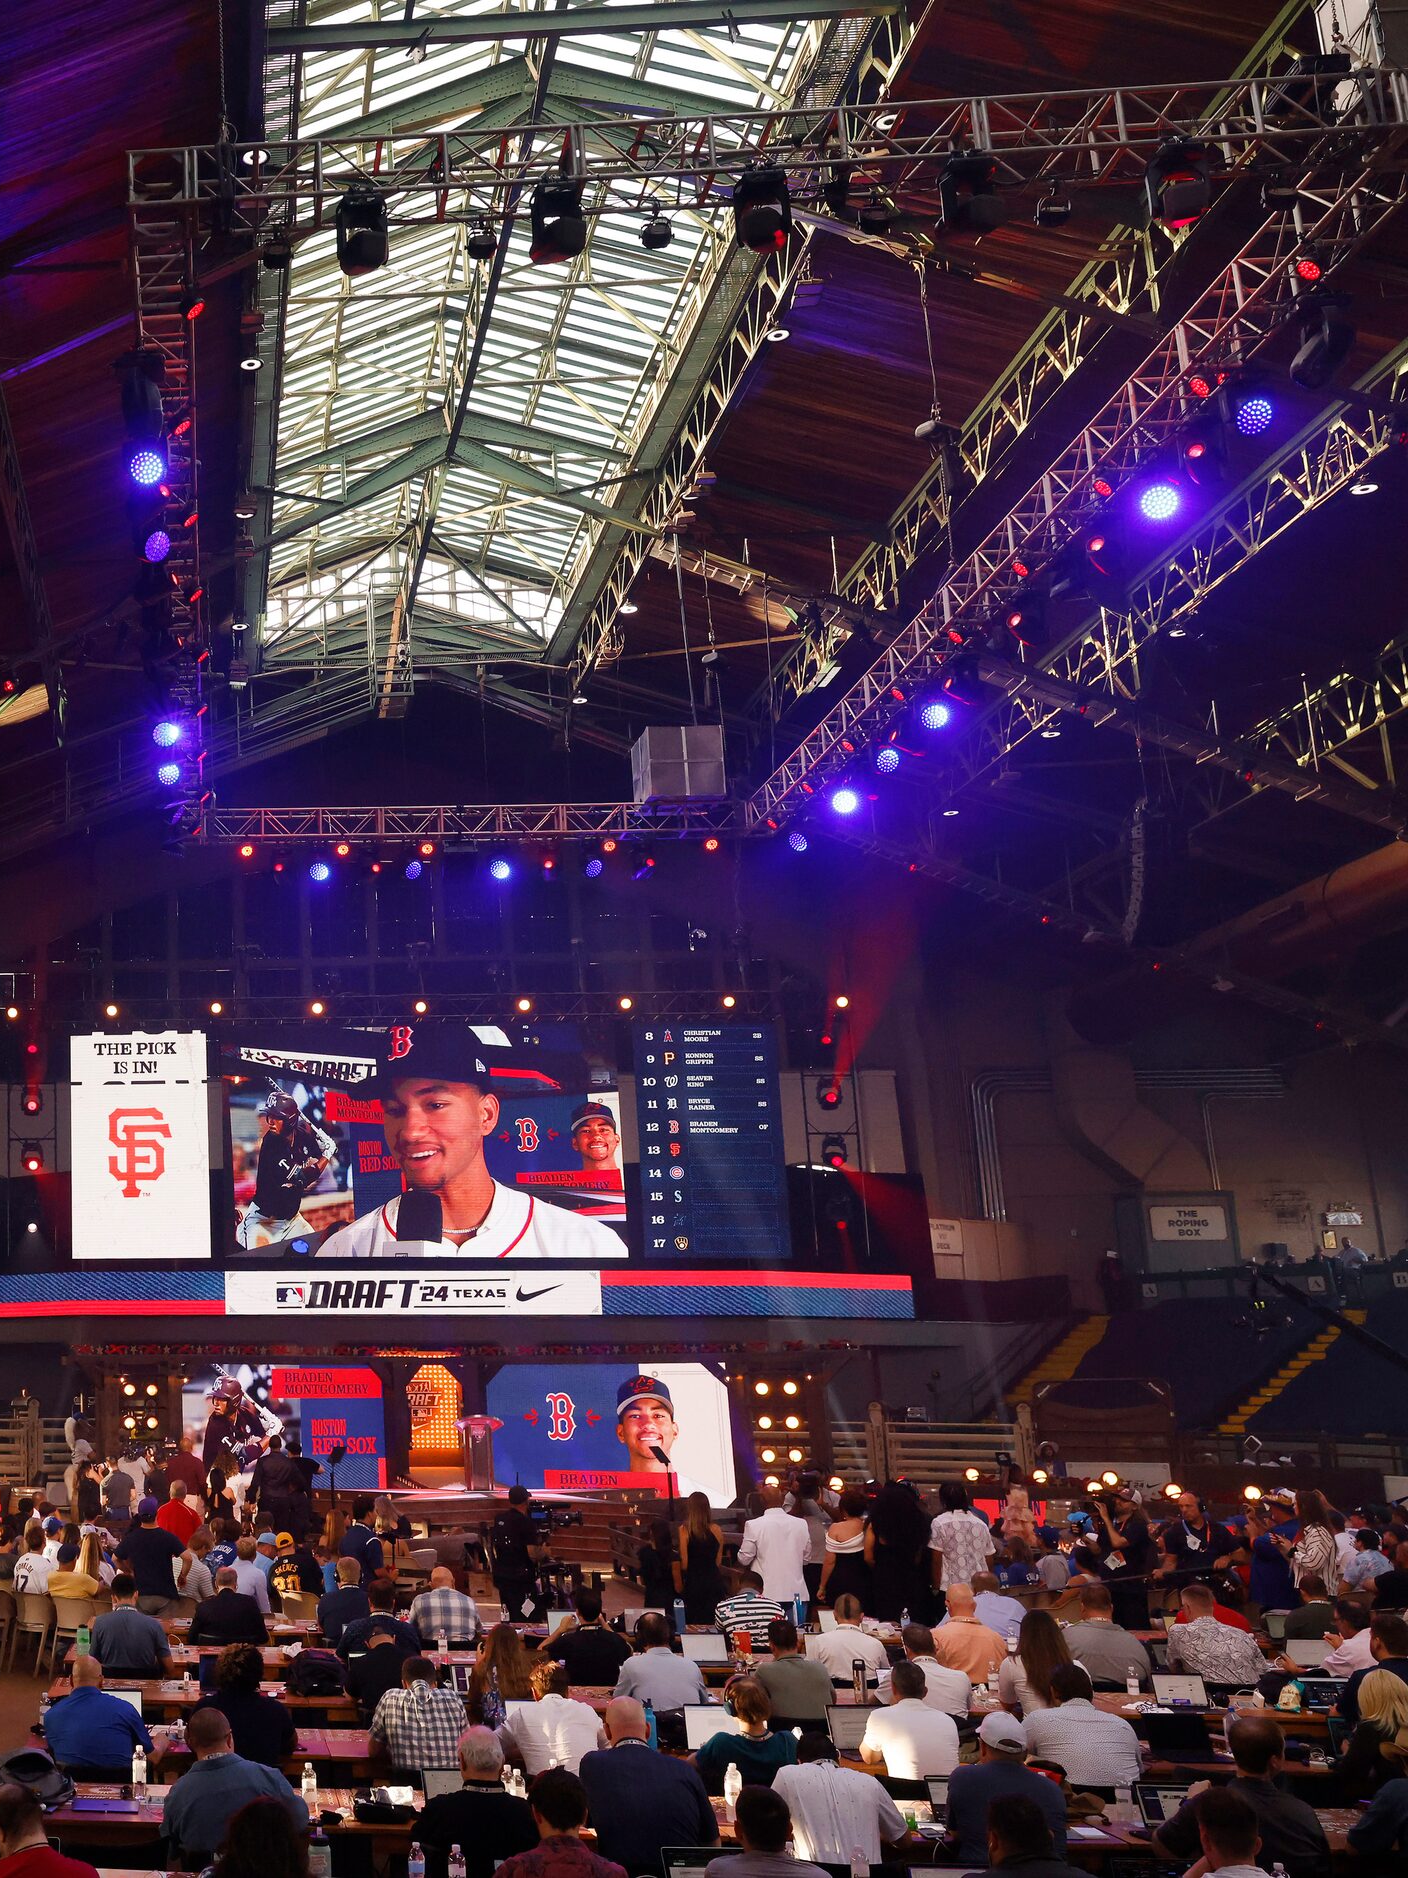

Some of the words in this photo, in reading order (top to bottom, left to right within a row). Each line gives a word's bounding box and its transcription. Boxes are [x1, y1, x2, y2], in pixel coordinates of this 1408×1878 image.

[645, 1032, 653, 1041] 8
[387, 1025, 414, 1061] B
[94, 1042, 132, 1056] THE
[136, 1042, 177, 1055] PICK
[646, 1055, 655, 1064] 9
[664, 1052, 675, 1065] P
[113, 1061, 128, 1074] IS
[132, 1060, 158, 1074] IN!
[642, 1077, 656, 1086] 10
[647, 1100, 658, 1109] 11
[646, 1123, 659, 1131] 12
[515, 1117, 540, 1152] B
[357, 1141, 382, 1156] BOSTON
[647, 1146, 661, 1154] 13
[359, 1156, 381, 1173] RED
[528, 1173, 574, 1182] BRADEN
[648, 1169, 662, 1178] 14
[550, 1181, 609, 1189] GOMERY
[650, 1192, 663, 1201] 15
[1177, 1210, 1197, 1218] THE
[651, 1216, 664, 1224] 16
[1168, 1219, 1209, 1228] ROPING
[1178, 1229, 1201, 1237] BOX
[653, 1239, 666, 1248] 17
[305, 1279, 420, 1308] DRAFT
[419, 1285, 449, 1302] '24
[453, 1288, 506, 1298] TEXAS
[284, 1372, 333, 1383] BRADEN
[284, 1384, 369, 1395] MONTGOMERY
[407, 1394, 442, 1406] RAFT
[545, 1391, 577, 1441] B
[311, 1418, 347, 1436] BOSTON
[346, 1436, 377, 1455] SOX
[559, 1473, 618, 1486] BRADEN
[274, 1563, 299, 1576] SKENES
[15, 1574, 29, 1592] 17
